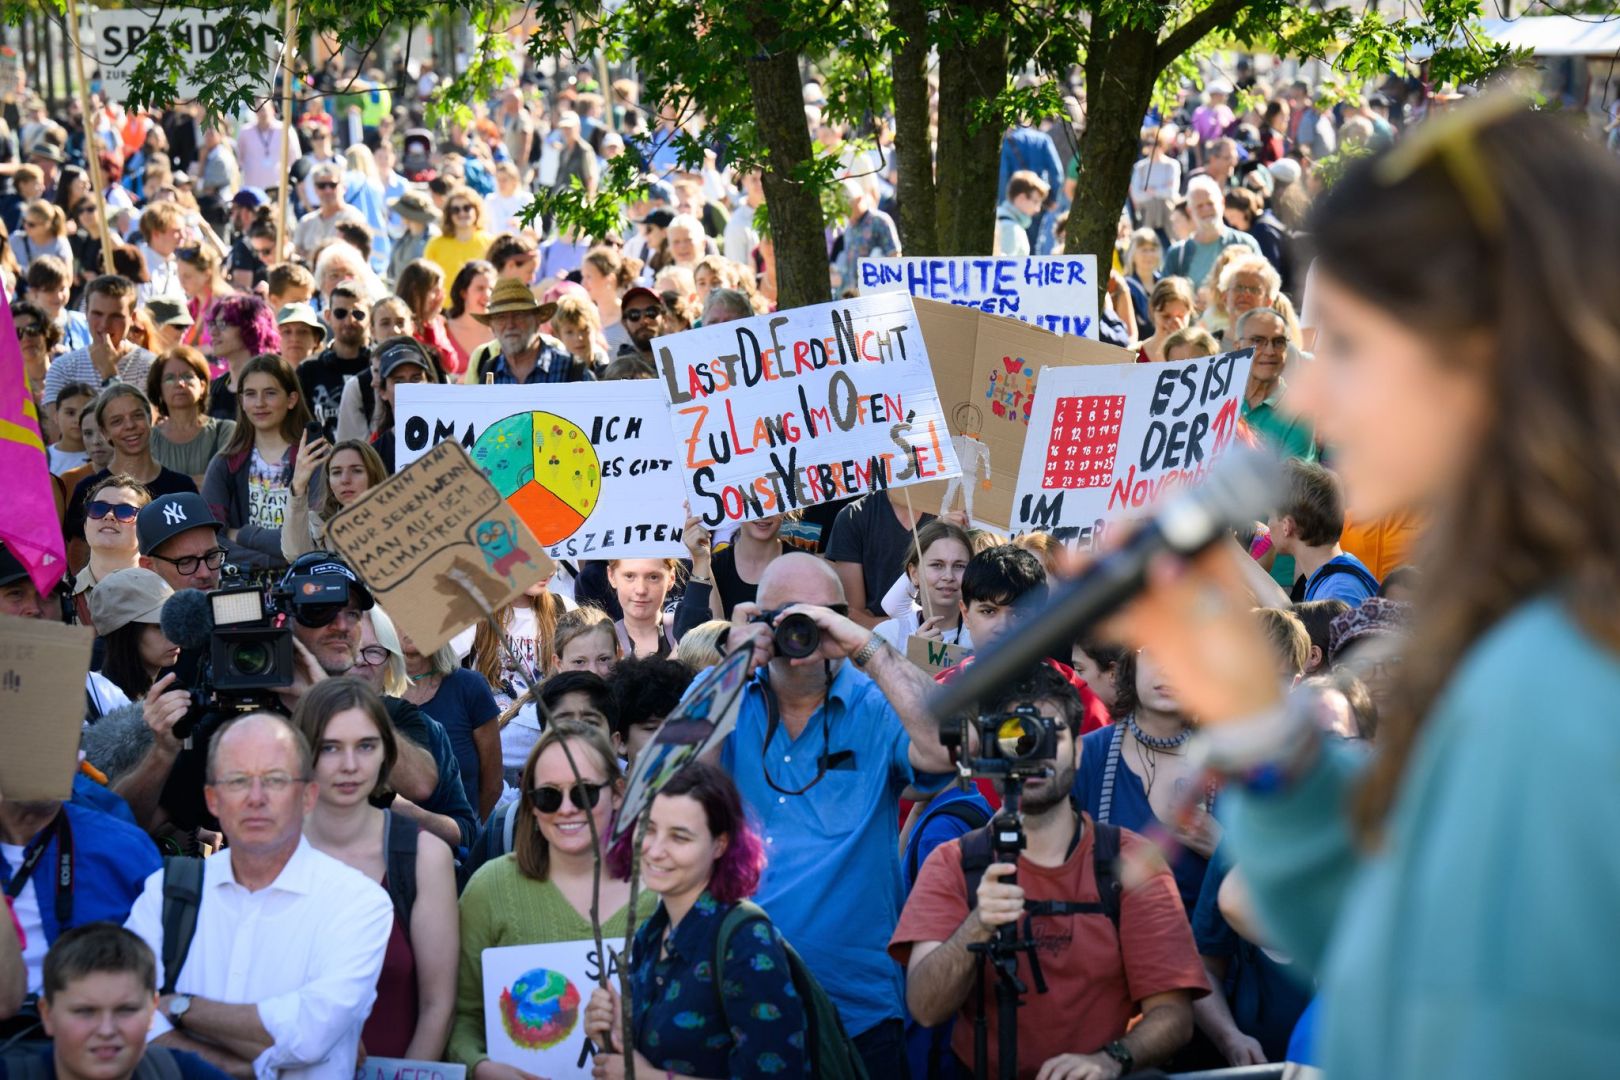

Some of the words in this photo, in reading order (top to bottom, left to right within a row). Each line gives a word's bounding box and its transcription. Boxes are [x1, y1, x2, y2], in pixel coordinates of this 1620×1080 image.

[862, 262, 902, 287] BIN
[908, 260, 1019, 299] HEUTE
[1024, 258, 1087, 287] HIER
[1061, 400, 1067, 408] 1
[1076, 399, 1083, 409] 2
[1092, 399, 1098, 408] 3
[1104, 399, 1111, 408] 4
[1116, 396, 1123, 406] 5
[1149, 363, 1199, 417] ES
[405, 415, 475, 450] OMA
[591, 416, 642, 446] ICH
[678, 405, 732, 469] ZU
[725, 398, 801, 455] LANG
[797, 383, 832, 439] IM
[1057, 411, 1064, 423] 6
[1075, 411, 1082, 423] 7
[1088, 410, 1096, 422] 8
[1103, 408, 1110, 421] 9
[1053, 426, 1063, 441] 11
[1071, 426, 1082, 443] 12
[1086, 425, 1096, 439] 13
[1099, 425, 1110, 436] 14
[1111, 424, 1119, 434] 15
[1066, 445, 1078, 456] 17
[1082, 445, 1092, 456] 18
[1107, 442, 1117, 454] 20
[1140, 412, 1210, 472] DER
[602, 456, 624, 478] ES
[629, 458, 673, 478] GIBT
[1044, 475, 1055, 486] 26
[1062, 476, 1073, 487] 27
[1089, 474, 1100, 486] 29
[1100, 473, 1112, 486] 30
[1064, 460, 1075, 471] 22
[1079, 460, 1090, 471] 23
[1093, 460, 1103, 470] 24
[1103, 456, 1114, 470] 25
[334, 507, 373, 537] MICH
[374, 472, 415, 505] KANN
[347, 527, 378, 553] NUR
[425, 460, 469, 495] WENN
[1019, 490, 1065, 526] IM
[359, 536, 402, 571] MAN
[406, 510, 435, 537] AUF
[438, 484, 472, 512] DEM
[369, 505, 472, 583] KLIMASTREIK
